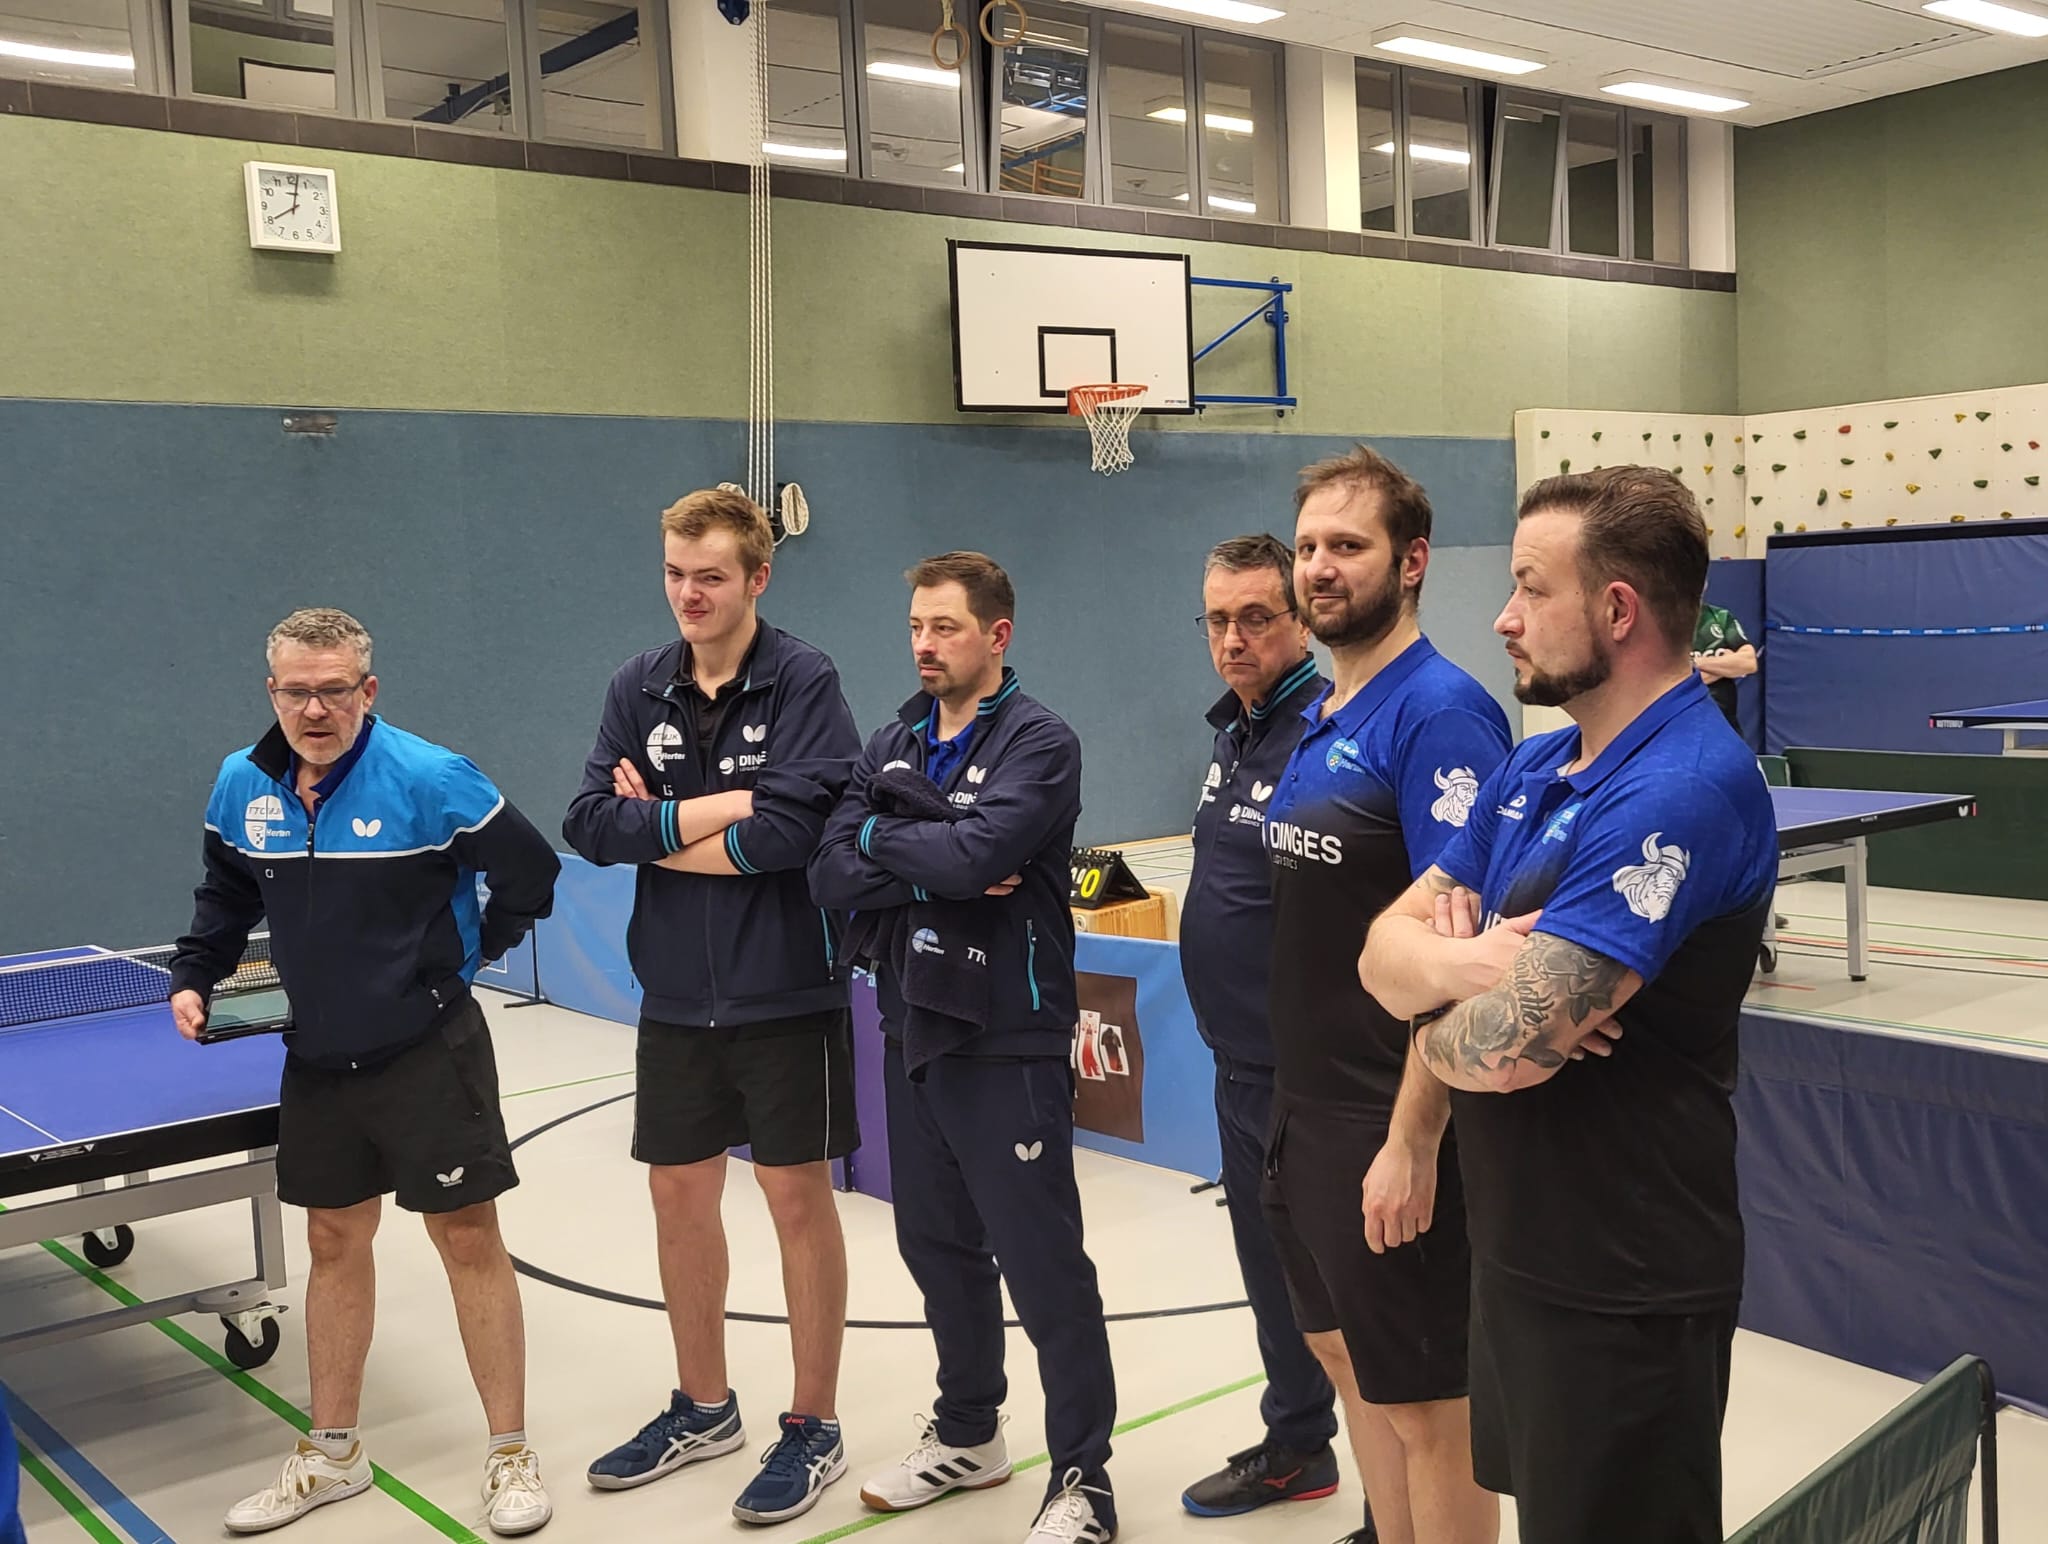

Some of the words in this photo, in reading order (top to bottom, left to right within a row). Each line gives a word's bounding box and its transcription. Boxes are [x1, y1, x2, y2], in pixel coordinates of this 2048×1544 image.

[312, 191, 320, 201] 2
[261, 201, 268, 211] 9
[319, 206, 326, 216] 3
[267, 216, 274, 225] 8
[315, 220, 322, 228] 4
[279, 226, 285, 235] 7
[292, 230, 299, 240] 6
[306, 228, 313, 238] 5
[1269, 821, 1343, 865] DINGES
[1080, 867, 1101, 899] 0
